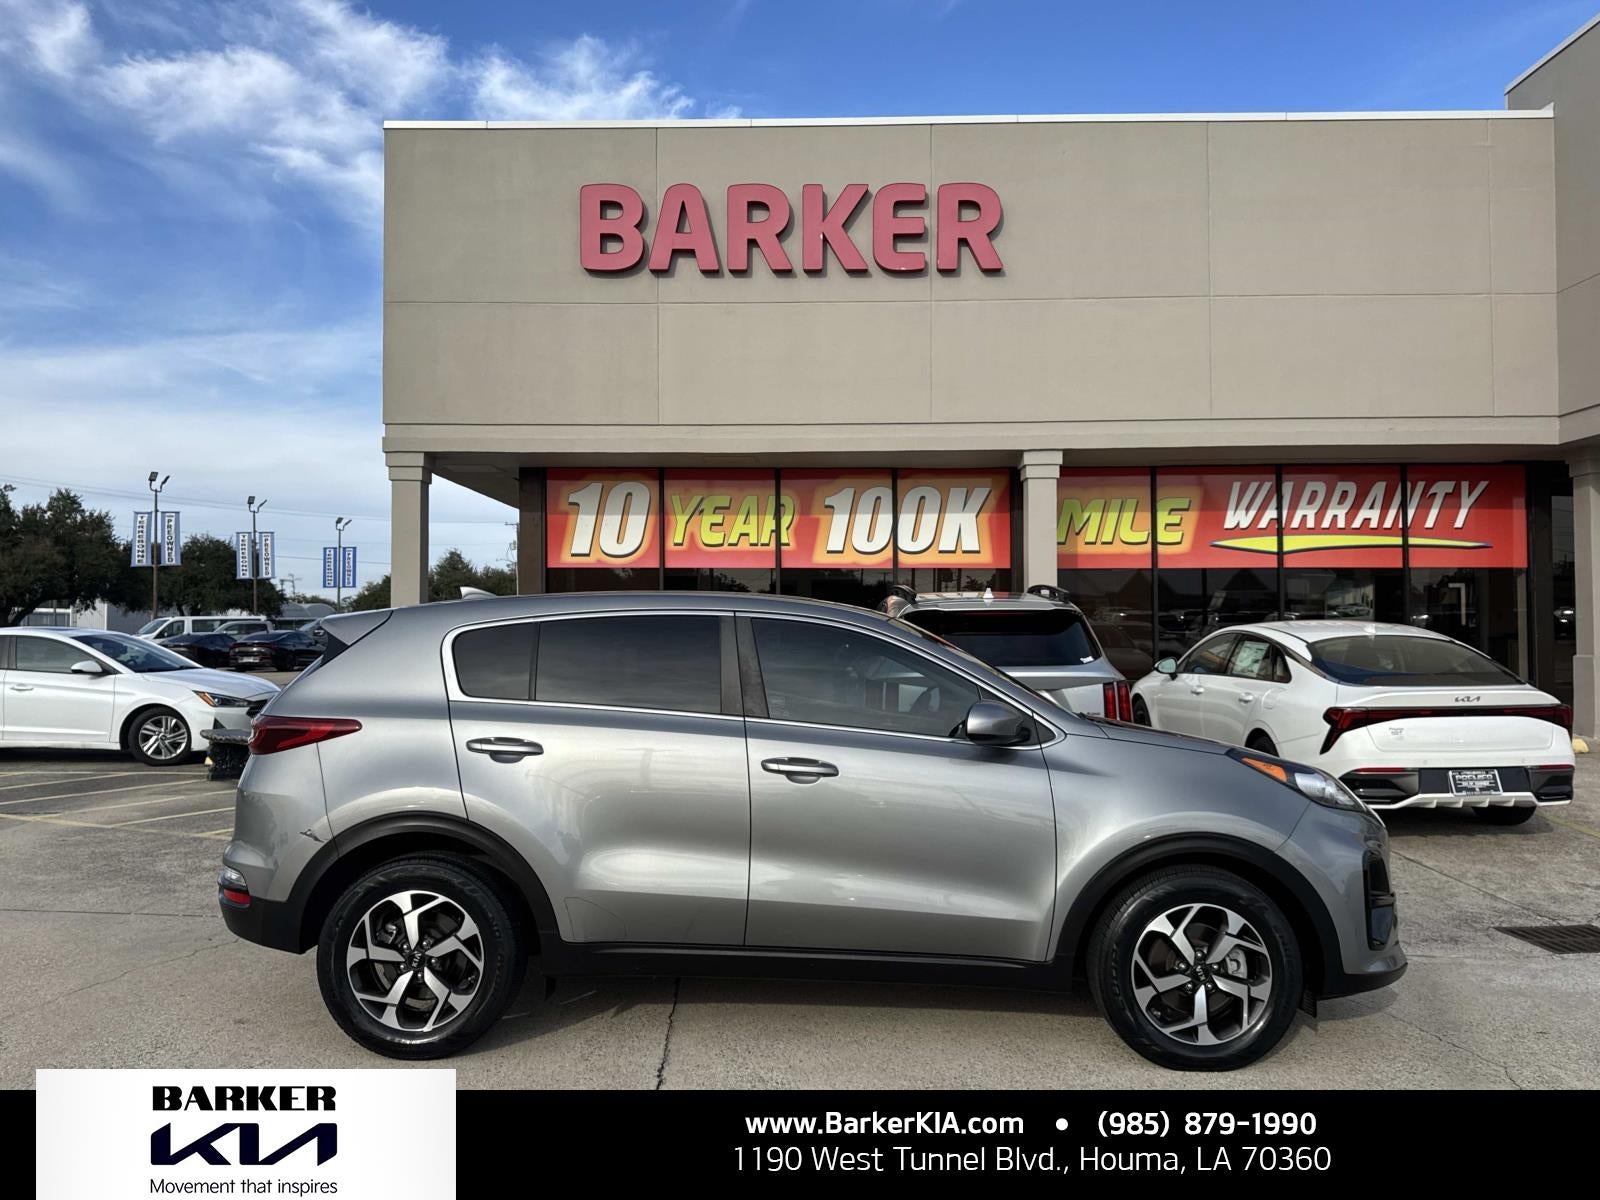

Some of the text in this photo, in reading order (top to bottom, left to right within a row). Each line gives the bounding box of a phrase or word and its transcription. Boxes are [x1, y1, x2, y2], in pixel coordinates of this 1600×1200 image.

[580, 183, 1004, 273] BARKER
[568, 480, 1490, 558] 10 YEAR 100K MILE WARRANTY
